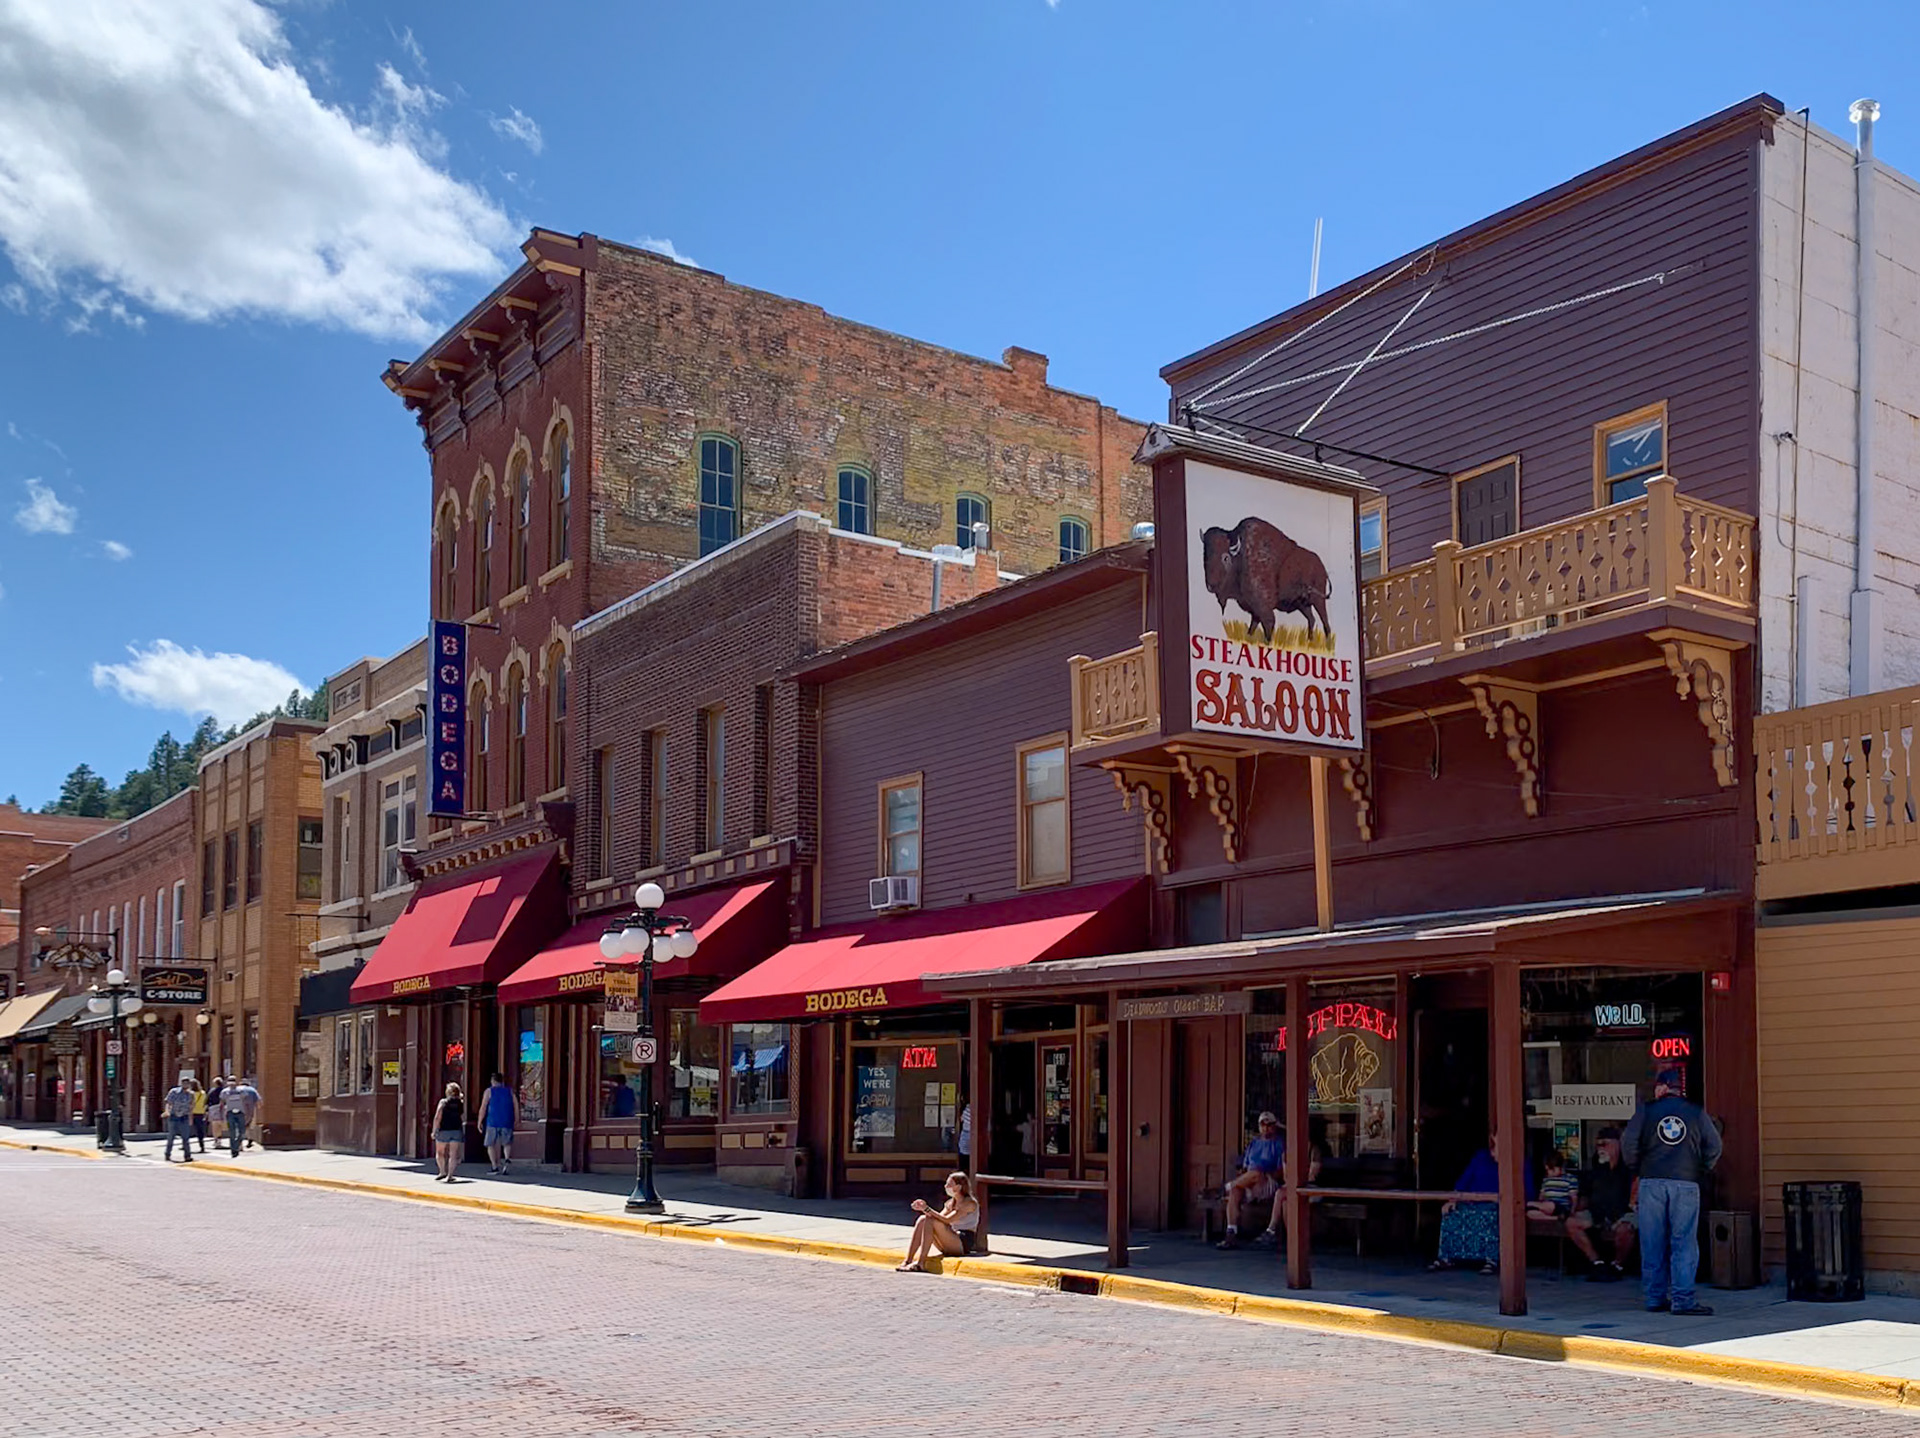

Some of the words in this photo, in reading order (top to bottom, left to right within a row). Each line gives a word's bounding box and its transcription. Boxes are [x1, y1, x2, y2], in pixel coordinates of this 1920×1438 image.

[1191, 634, 1354, 683] STEAKHOUSE
[1195, 668, 1355, 741] SALOON
[440, 635, 460, 799] BODEGA
[146, 989, 202, 999] C-STORE
[393, 976, 430, 994] BODEGA
[805, 987, 888, 1012] BODEGA
[1204, 995, 1224, 1012] BAR
[1595, 1005, 1620, 1026] We
[902, 1047, 938, 1068] ATM
[1652, 1038, 1690, 1057] OPEN
[868, 1067, 888, 1079] YES,
[1554, 1095, 1633, 1106] RESTAURANT
